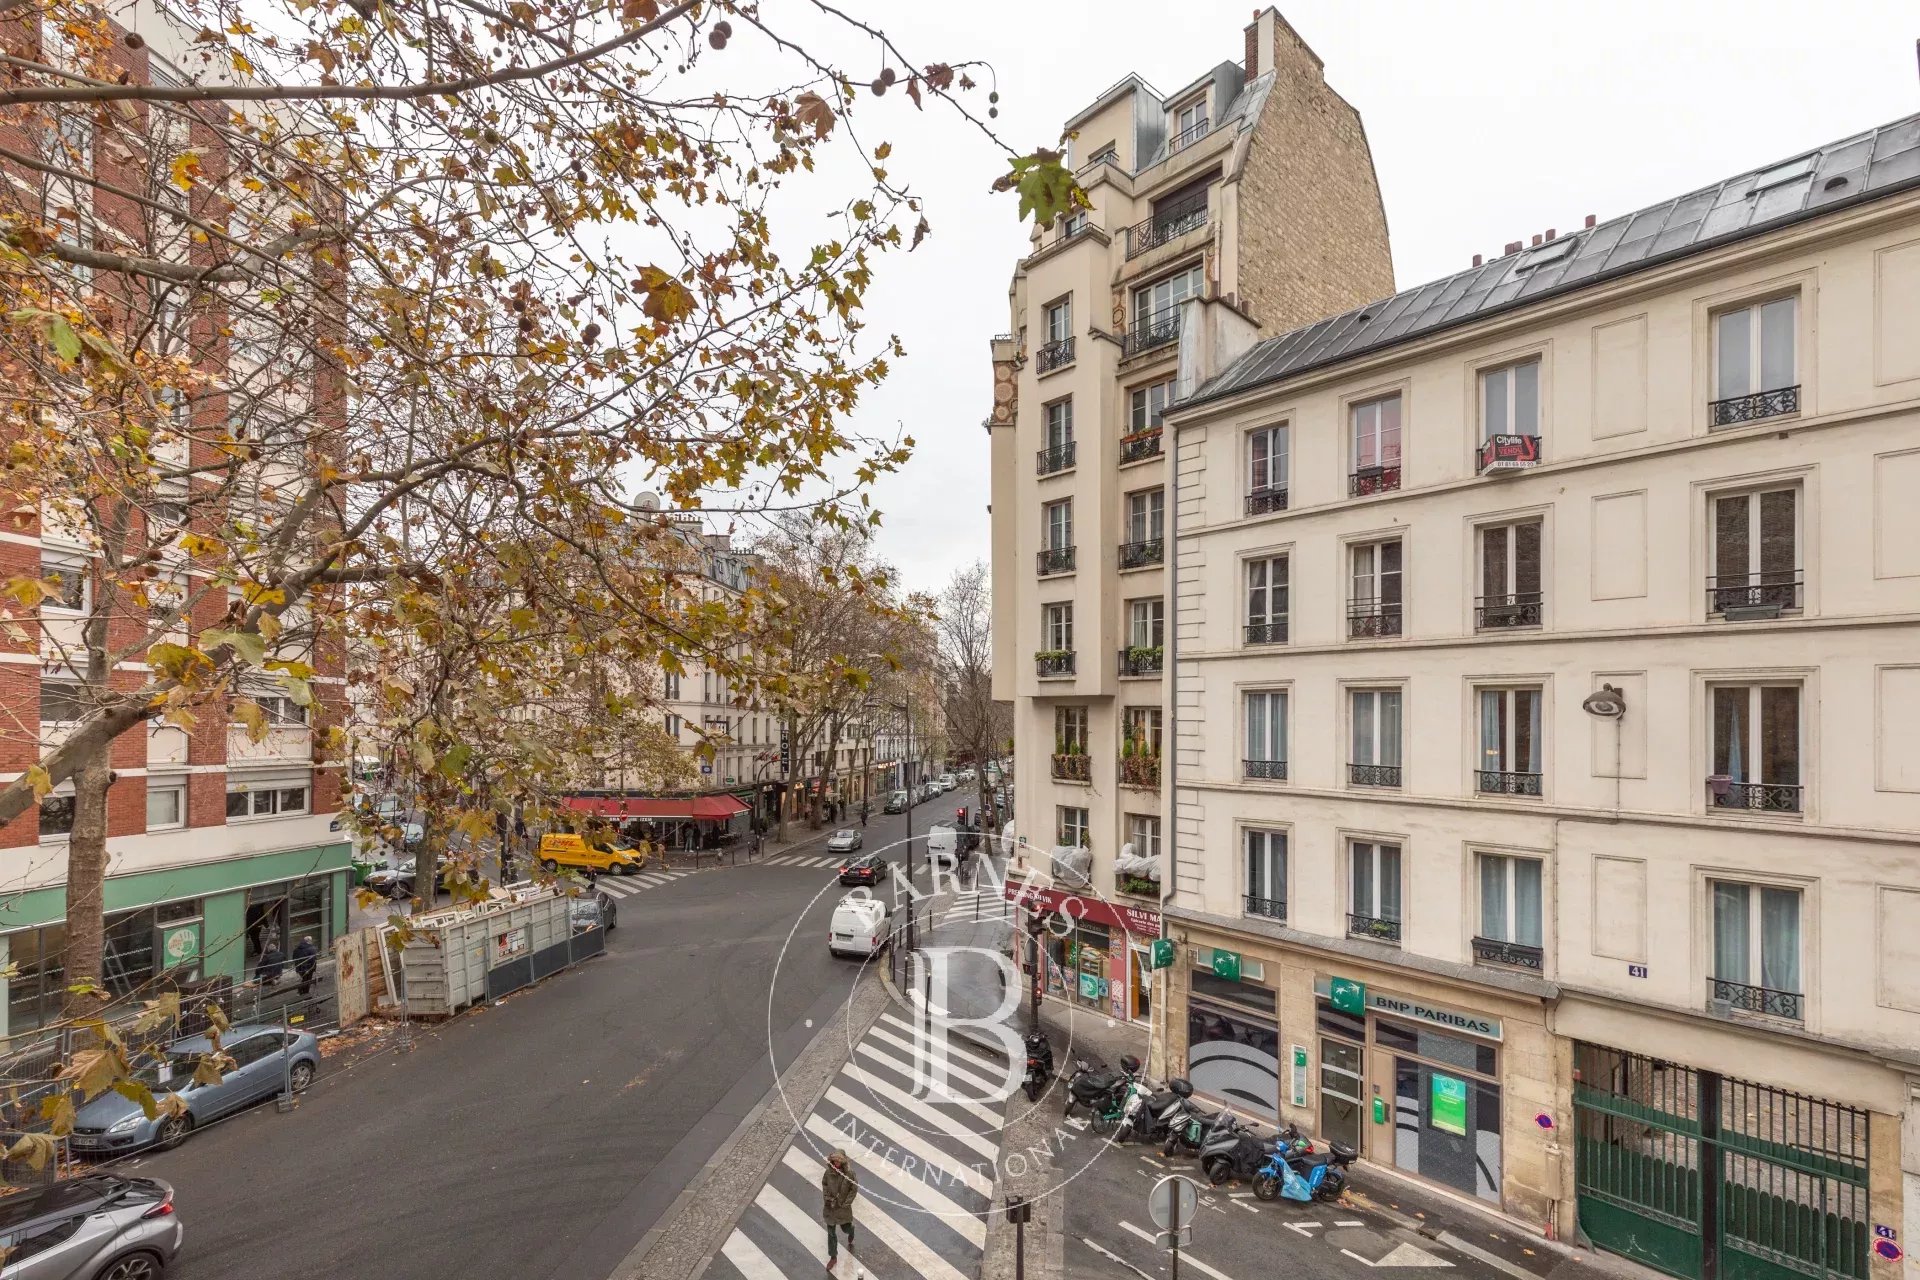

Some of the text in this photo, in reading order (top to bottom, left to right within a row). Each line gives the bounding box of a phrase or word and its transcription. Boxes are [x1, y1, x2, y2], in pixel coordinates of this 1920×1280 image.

[781, 733, 789, 773] HOTEL
[1126, 908, 1148, 920] SILVI
[1631, 966, 1644, 978] 41
[1376, 996, 1491, 1033] BNP PARIBAS
